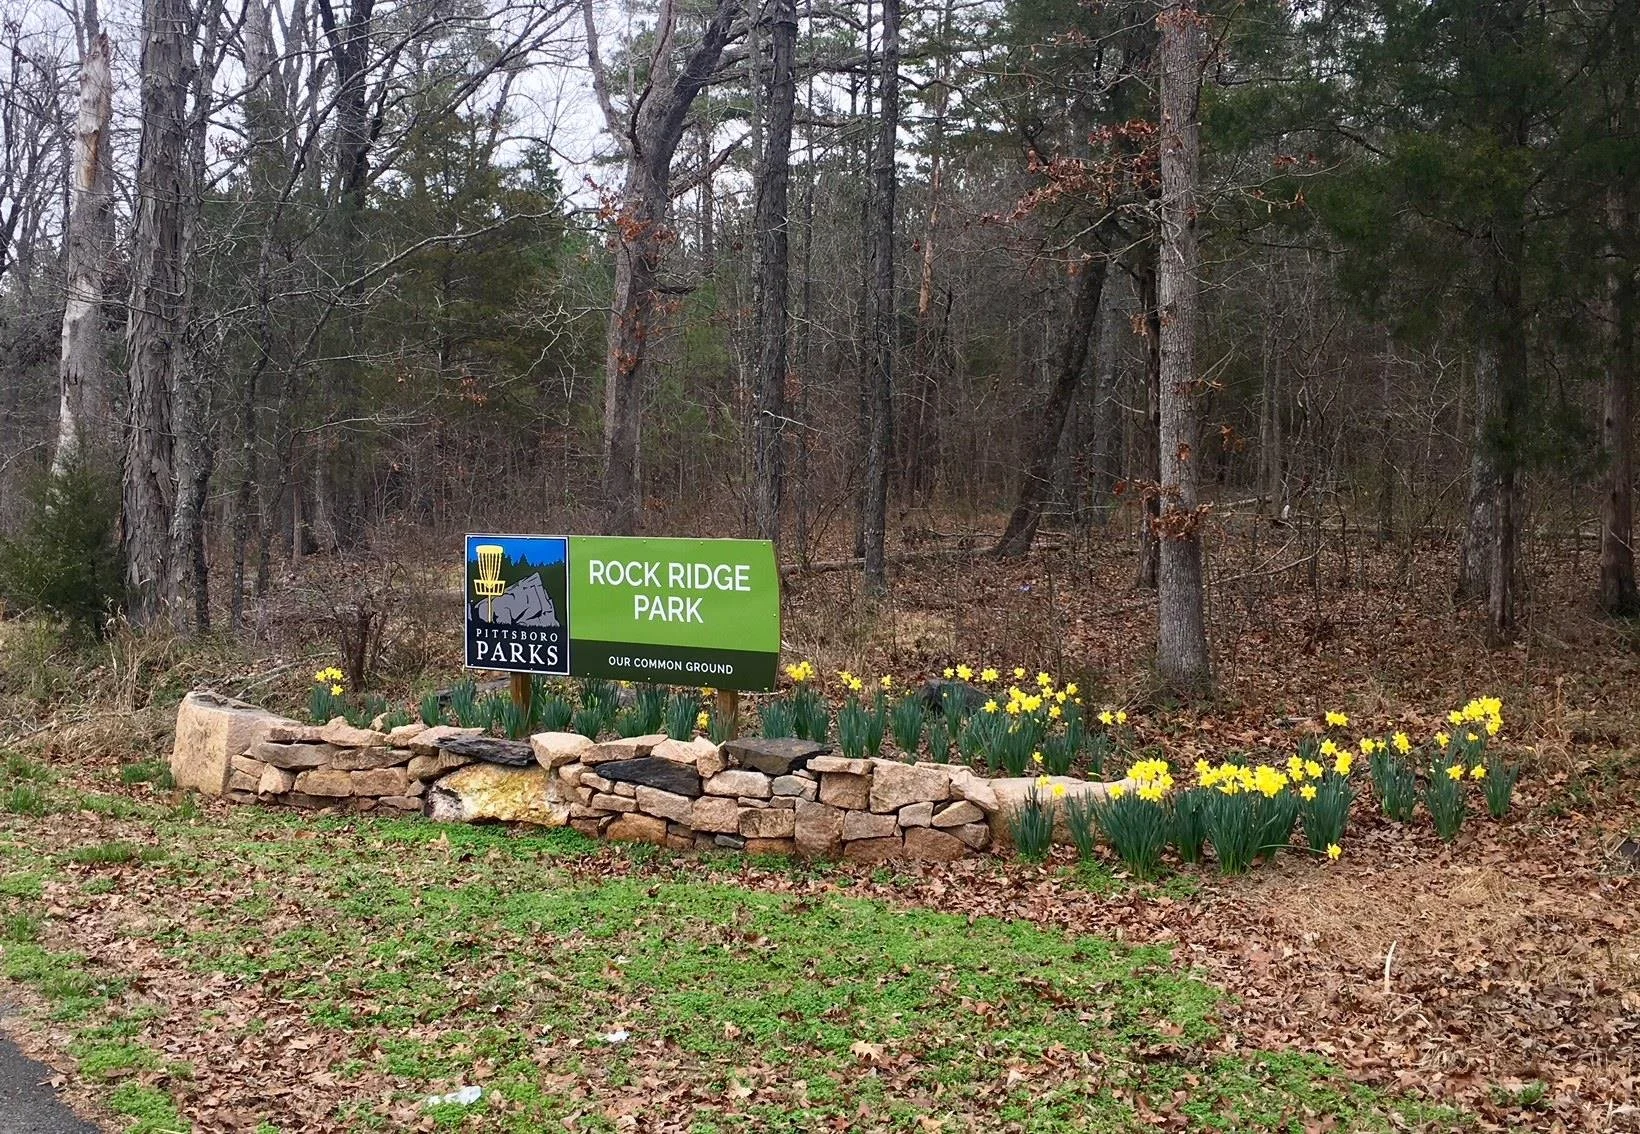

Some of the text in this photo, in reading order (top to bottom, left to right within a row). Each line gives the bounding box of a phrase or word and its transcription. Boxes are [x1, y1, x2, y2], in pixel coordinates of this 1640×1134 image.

[589, 559, 751, 592] ROCK RIDGE
[634, 594, 704, 624] PARK
[476, 628, 558, 643] PITTSBORO
[476, 640, 558, 666] PARKS
[608, 656, 733, 675] OUR COMMON GROUND
